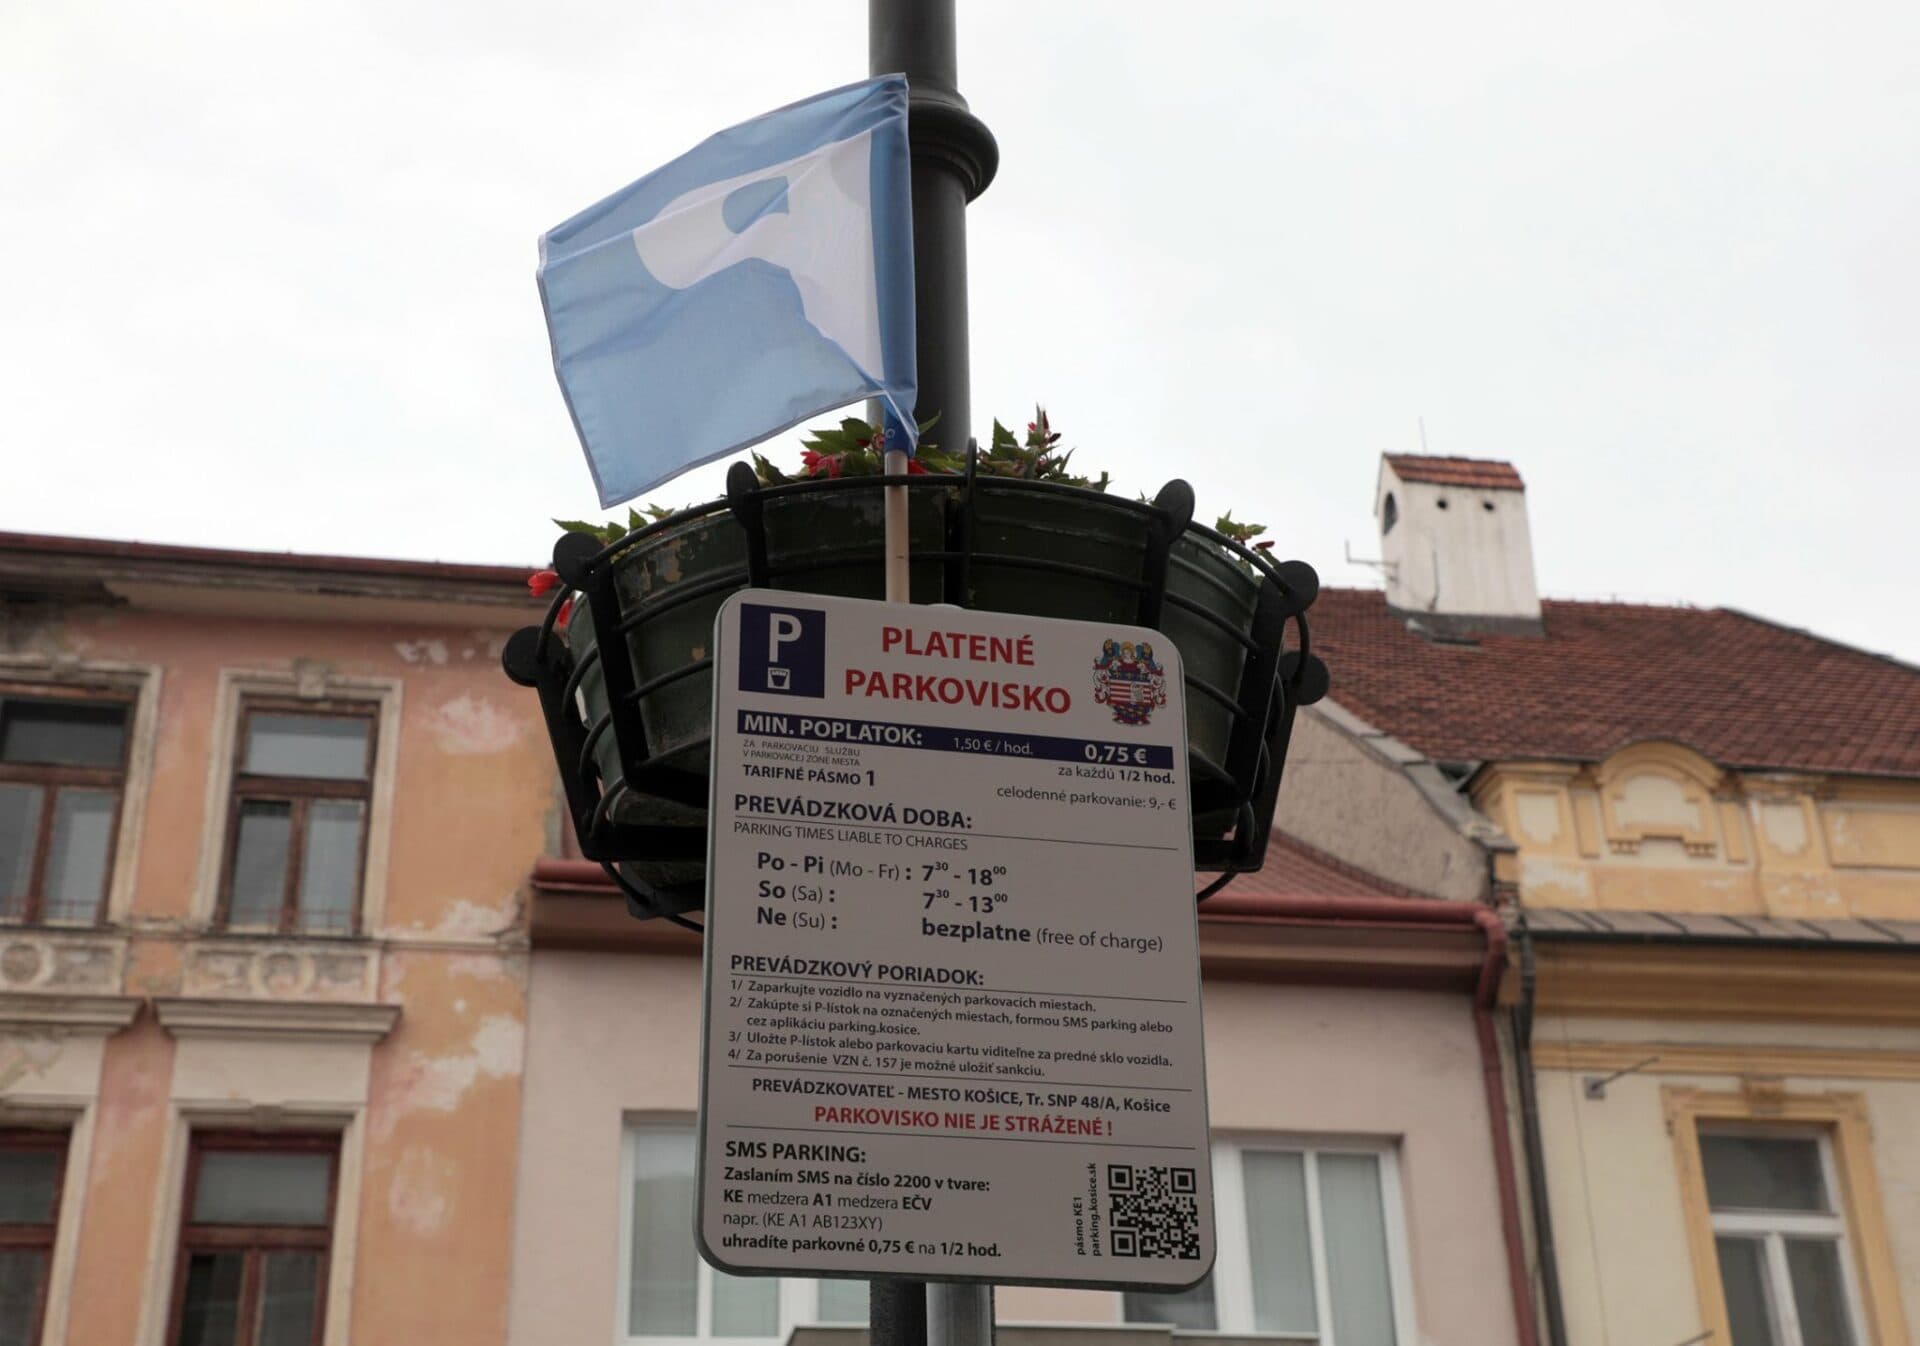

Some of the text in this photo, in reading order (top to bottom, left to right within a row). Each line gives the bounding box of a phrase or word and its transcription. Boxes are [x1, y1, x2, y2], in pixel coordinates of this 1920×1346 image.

[768, 612, 802, 663] P
[882, 626, 1035, 667] PLATENÉ
[845, 668, 1071, 714] PARKOVISKO
[744, 714, 922, 746] MIN. POPLATOK:
[953, 737, 981, 751] 1,50
[1003, 740, 1034, 755] hod.
[1084, 743, 1129, 763] 0,75
[742, 763, 875, 787] TARIFNÉ PÁSMO 1
[1057, 766, 1073, 777] za
[1119, 769, 1141, 782] 1/2
[1143, 770, 1176, 785] hod.
[734, 793, 972, 829] PREVÁDZKOVÁ DOBA:
[996, 785, 1067, 802] celodenné
[1069, 791, 1146, 809] parkovanie:
[733, 821, 968, 851] PARKING TIMES LIABLE TO CHARGES
[757, 851, 785, 871] Po
[804, 855, 824, 875] Pi
[829, 860, 863, 878] (Mo
[878, 863, 900, 881] Fr)
[758, 879, 786, 899] So
[791, 884, 823, 905] (Sa)
[757, 906, 787, 926] Ne
[792, 911, 825, 931] (Su)
[922, 916, 1031, 943] bezplatne
[1036, 927, 1075, 946] (free
[1078, 930, 1097, 947] of
[1099, 931, 1163, 954] charge)
[731, 954, 984, 986] PREVÁDZKOVÝ PORIADOK:
[747, 980, 816, 998] Zaparkujte
[818, 985, 863, 999] vozidlo
[865, 990, 881, 999] na
[883, 991, 962, 1006] vyznačených
[1039, 999, 1097, 1013] miestach.
[746, 1016, 921, 1036] cez aplikáciu parking.kosice.
[747, 997, 800, 1013] Zakúpte
[802, 1000, 812, 1012] si
[862, 1007, 878, 1016] na
[880, 1007, 953, 1022] označených
[955, 1010, 1013, 1025] miestach,
[1015, 1012, 1060, 1027] formou
[1062, 1015, 1089, 1028] SMS
[1090, 1018, 1137, 1034] parking
[1139, 1020, 1173, 1033] alebo
[746, 1049, 762, 1061] Za
[764, 1051, 828, 1065] porušenie
[832, 1054, 859, 1067] VZN
[876, 1056, 898, 1069] 157
[899, 1058, 912, 1072] je
[914, 1059, 956, 1072] možné
[959, 1061, 995, 1074] uložiť
[995, 1063, 1046, 1077] sankciu.
[747, 1031, 787, 1046] Uložte
[838, 1037, 874, 1050] alebo
[876, 1039, 944, 1054] parkovaciu
[946, 1042, 980, 1056] kartu
[981, 1045, 1035, 1059] viditeľne
[1037, 1050, 1051, 1060] za
[1053, 1050, 1097, 1063] predné
[1099, 1051, 1125, 1064] sklo
[1126, 1054, 1173, 1067] vozidla.
[752, 1077, 895, 1099] PREVÁDZKOVATEĽ
[907, 1086, 961, 1102] MESTO
[964, 1088, 1023, 1107] KOŠICE,
[1025, 1092, 1044, 1107] Tr.
[1047, 1093, 1078, 1108] SNP
[1080, 1095, 1120, 1112] 48/A,
[1123, 1097, 1171, 1113] Košice
[814, 1106, 940, 1128] PARKOVISKO
[944, 1111, 977, 1130] NIE
[979, 1114, 1001, 1131] JE
[1004, 1114, 1103, 1136] STRÁŽENÉ
[725, 1140, 866, 1164] SMS PARKING:
[724, 1166, 990, 1192] Zaslaním SMS na číslo 2200 v tvare:
[723, 1189, 933, 1211] KE medzera A1 medzera EČV
[1086, 1162, 1103, 1257] parking.kosice.sk
[723, 1211, 883, 1233] napr. (KE A1 AB123XY)
[1072, 1196, 1087, 1256] pásmo KE1
[722, 1233, 789, 1249] uhradíte
[792, 1236, 865, 1253] parkovné
[868, 1239, 901, 1255] 0,75
[918, 1243, 936, 1255] na
[940, 1241, 964, 1256] 1/2
[967, 1241, 1002, 1257] hod.
